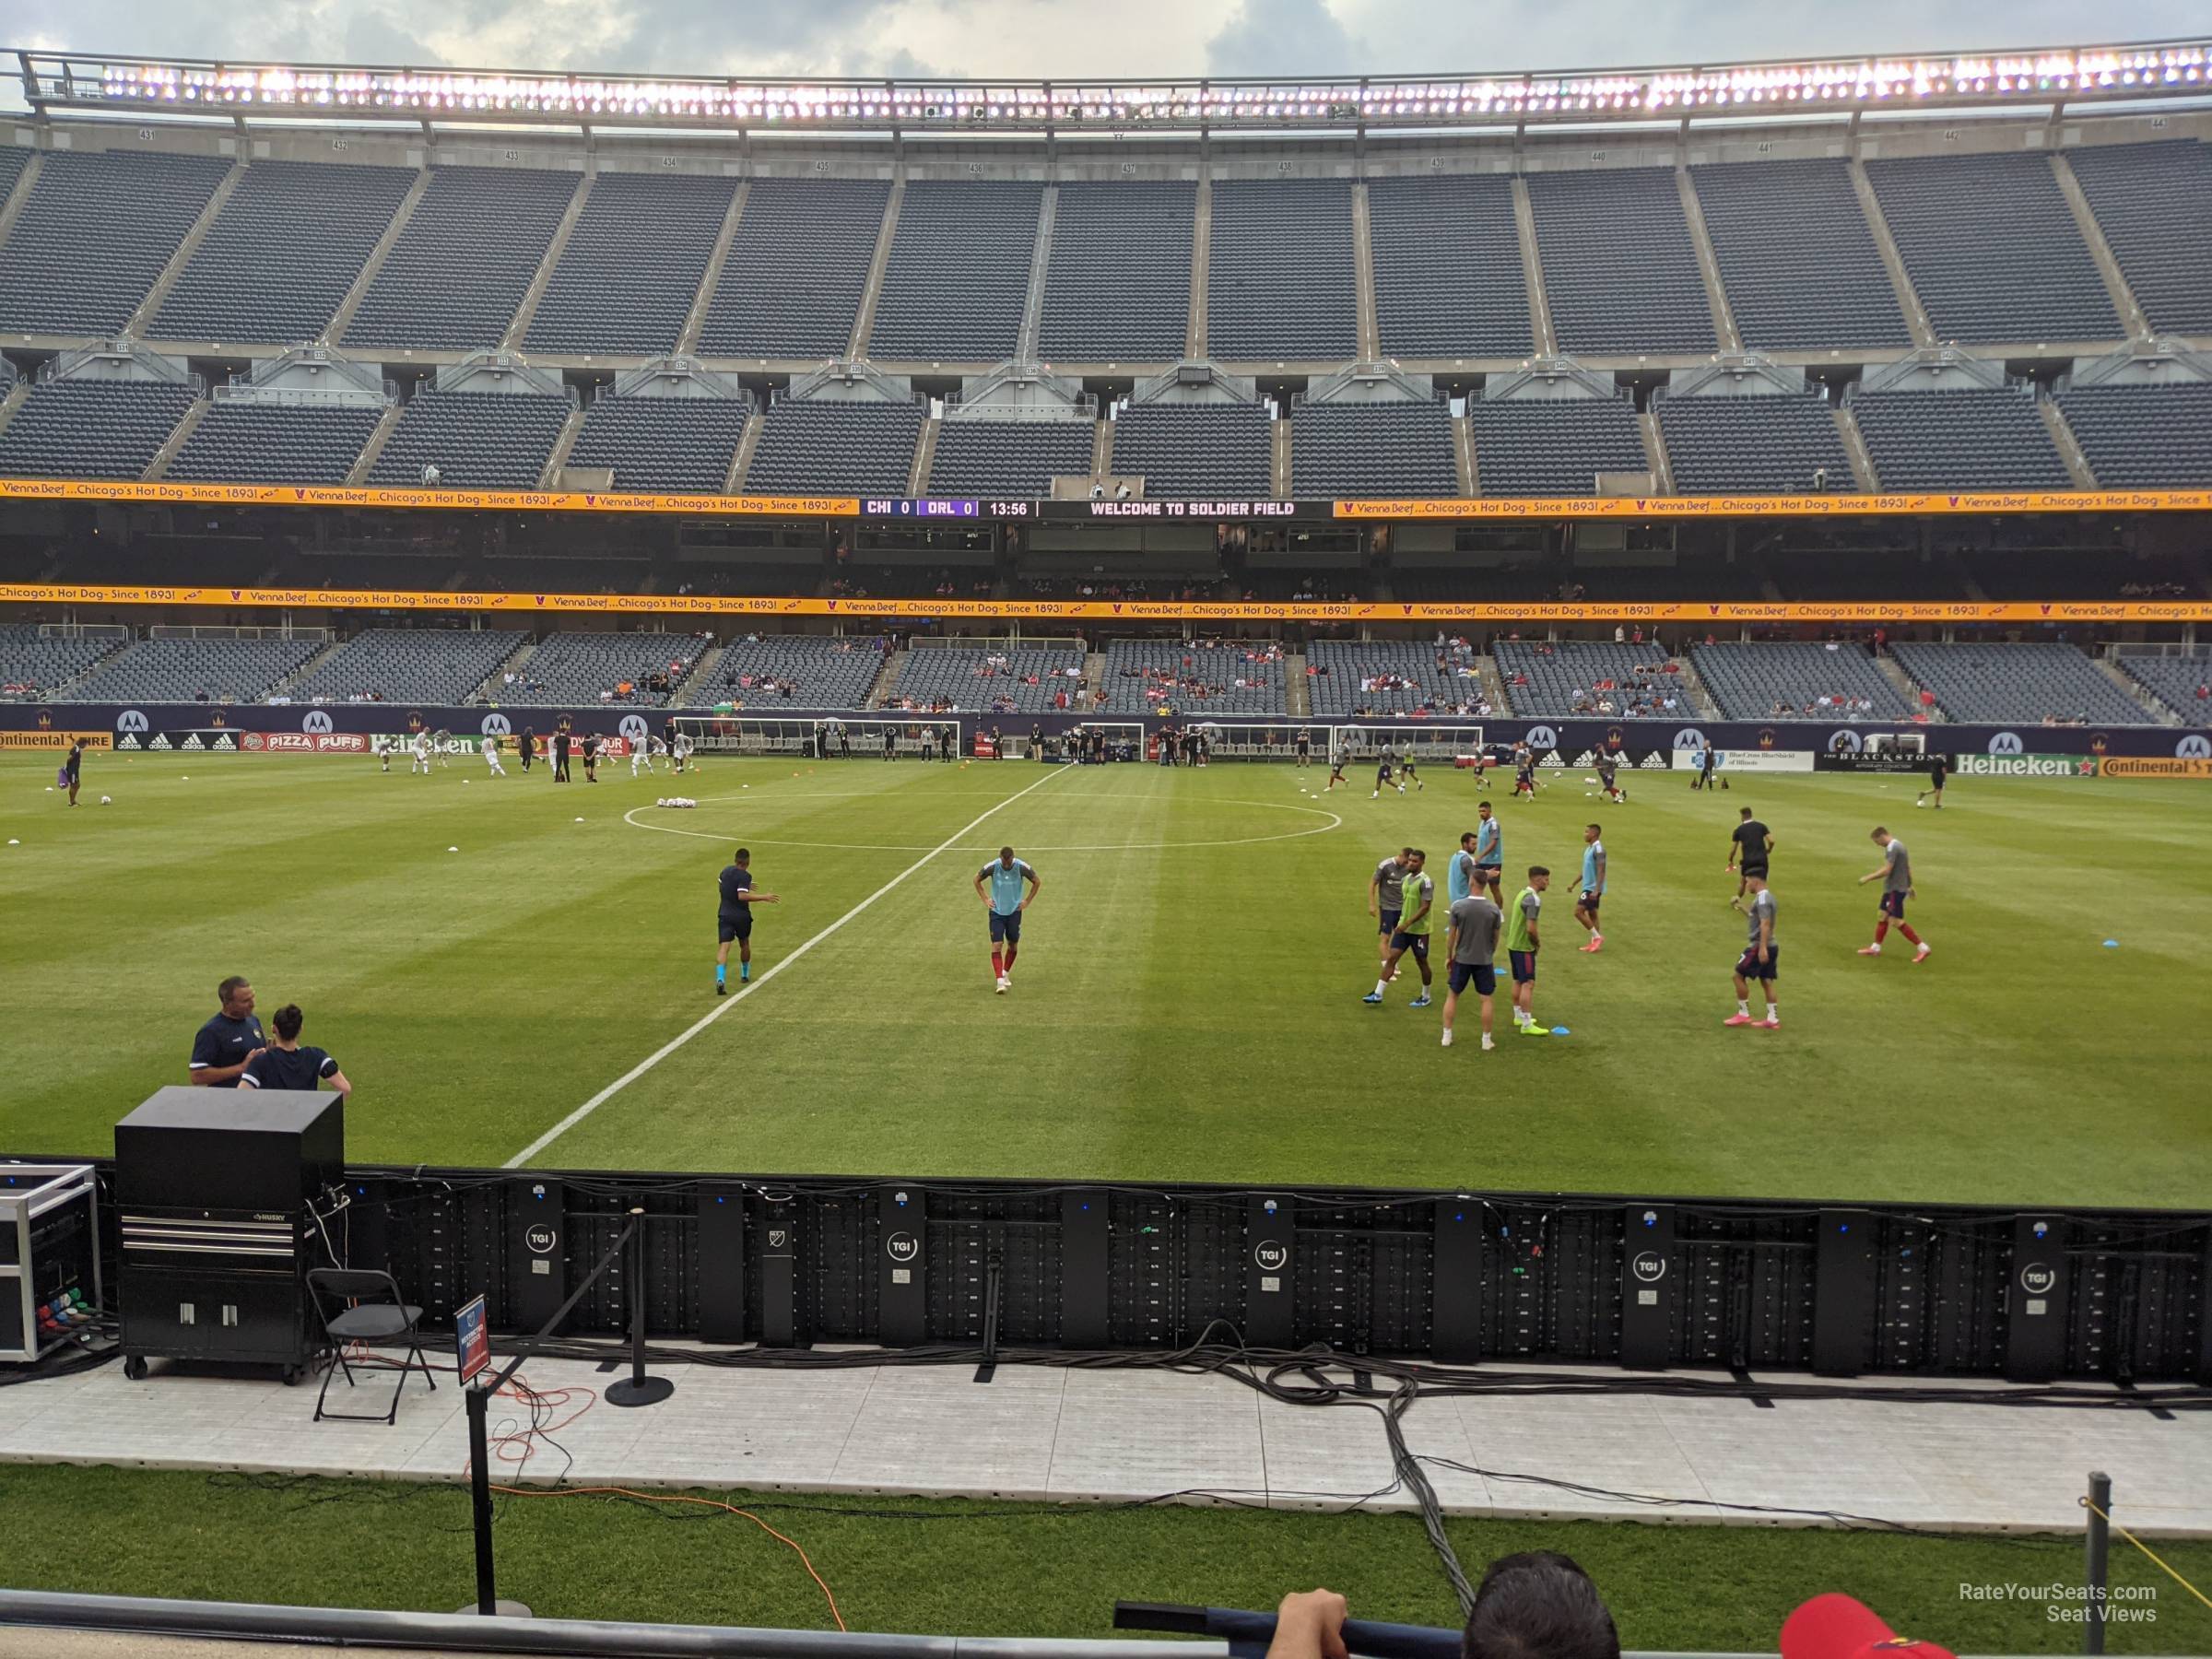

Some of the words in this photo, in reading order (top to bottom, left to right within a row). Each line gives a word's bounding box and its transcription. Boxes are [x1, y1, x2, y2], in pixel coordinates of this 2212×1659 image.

[141, 131, 155, 140] 431
[1946, 129, 1959, 140] 442
[334, 140, 347, 150] 432
[1759, 143, 1772, 153] 441
[505, 150, 518, 160] 433
[1593, 151, 1606, 161] 440
[664, 157, 676, 166] 434
[817, 161, 829, 171] 435
[1431, 158, 1444, 167] 439
[970, 163, 982, 172] 436
[1123, 163, 1135, 173] 437
[2, 482, 40, 493] Vienna
[136, 487, 156, 495] Hot
[192, 488, 221, 498] Since
[226, 488, 258, 498] 1893!
[310, 490, 344, 500] Vienna
[436, 494, 453, 502] Hot
[488, 495, 516, 504] Since
[520, 495, 550, 504] 1893!
[600, 497, 632, 507] Vienna
[721, 499, 738, 509] Hot
[771, 500, 798, 510] Since
[803, 501, 832, 510] 1893!
[868, 502, 891, 513] CHI
[901, 502, 910, 514] 0
[928, 502, 955, 514] ORL
[964, 502, 972, 514] 0
[991, 502, 1028, 515] 13:56
[1091, 503, 1160, 515] WELCOME
[1166, 503, 1184, 515] TO
[1190, 502, 1249, 515] SOLDIER
[1254, 502, 1294, 515] FIELD
[1358, 504, 1391, 513] Vienna
[1481, 502, 1500, 512] Hot
[1535, 502, 1562, 512] Since
[1568, 501, 1598, 511] 1893!
[1651, 501, 1686, 510] Vienna
[1782, 500, 1801, 509] Hot
[1839, 500, 1869, 509] Since
[1874, 499, 1908, 508] 1893!
[58, 589, 76, 597] Hot
[112, 590, 140, 598] Since
[145, 590, 176, 600] 1893!
[251, 592, 283, 601] Vienna
[372, 594, 391, 604] Hot
[424, 595, 451, 604] Since
[454, 595, 484, 605] 1893!
[554, 597, 586, 606] Vienna
[670, 599, 688, 607] Hot
[719, 600, 745, 608] Since
[749, 600, 777, 609] 1893!
[845, 602, 877, 612] Vienna
[958, 604, 975, 612] Hot
[1006, 604, 1031, 612] Since
[1035, 605, 1063, 613] 1893!
[1131, 605, 1161, 614] Vienna
[1243, 606, 1261, 615] Hot
[1292, 606, 1319, 615] Since
[1323, 606, 1351, 615] 1893!
[1421, 606, 1453, 615] Vienna
[1540, 606, 1559, 615] Hot
[1593, 606, 1619, 615] Since
[1624, 606, 1654, 615] 1893!
[1856, 606, 1876, 615] Hot
[1912, 606, 1942, 615] Since
[1947, 606, 1980, 615] 1893!
[269, 735, 313, 748] PIZZA
[319, 735, 363, 748] PUFF
[1840, 753, 1936, 761] BLACKSTON
[1956, 755, 2072, 775] Heineken
[2103, 759, 2188, 775] Continental
[1581, 891, 1587, 900] 6
[1418, 938, 1424, 949] 4
[532, 1234, 548, 1243] TGI
[893, 1242, 911, 1252] TGI
[1261, 1251, 1279, 1260] TGI
[1639, 1262, 1657, 1272] TGI
[2028, 1274, 2047, 1283] TGI
